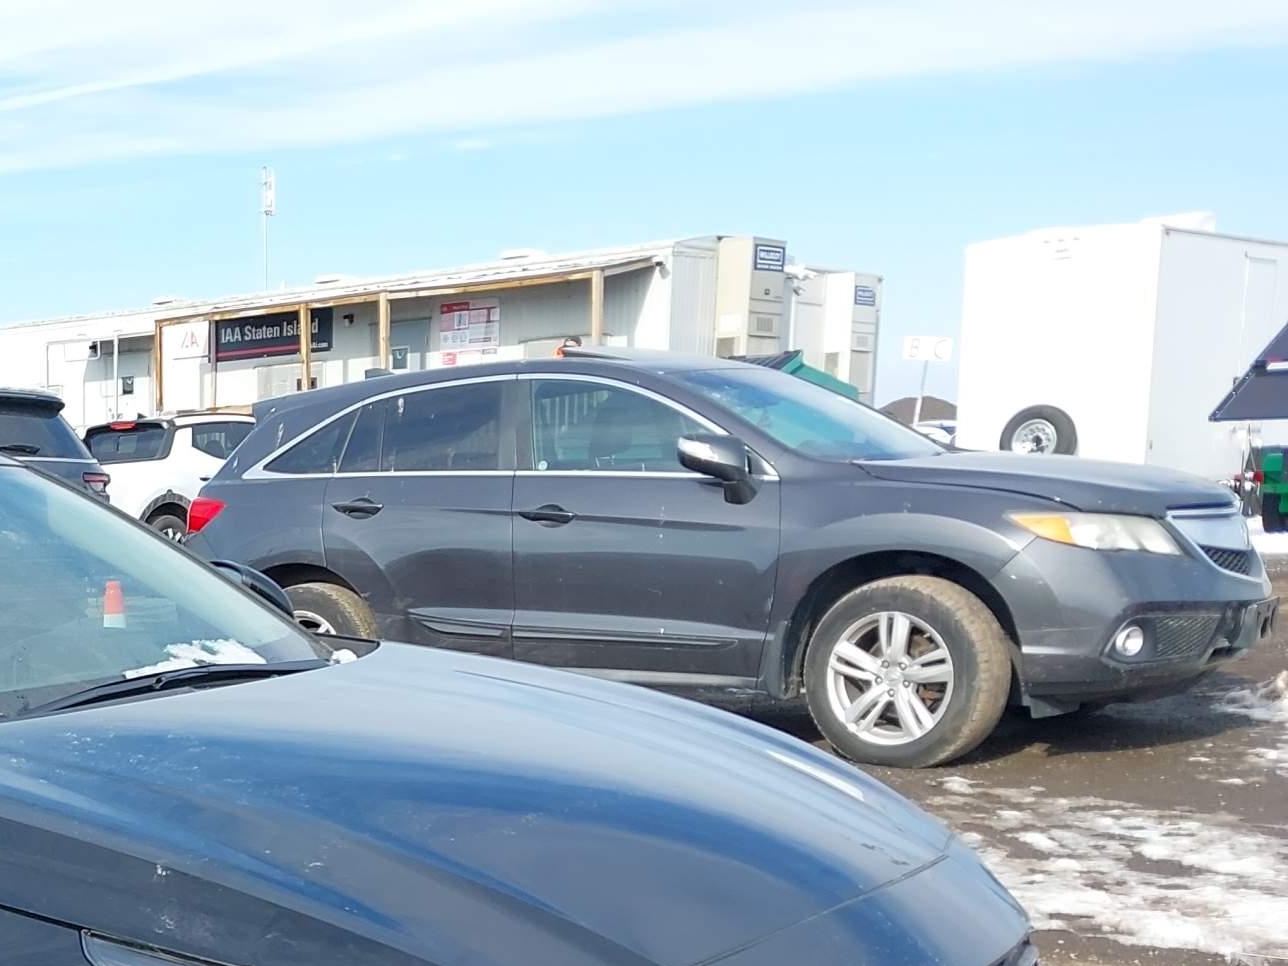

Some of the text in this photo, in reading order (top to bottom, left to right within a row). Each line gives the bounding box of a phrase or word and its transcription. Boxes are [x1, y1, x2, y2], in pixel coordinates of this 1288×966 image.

[221, 328, 242, 343] IAA
[244, 323, 280, 341] Staten
[283, 318, 319, 337] Islad
